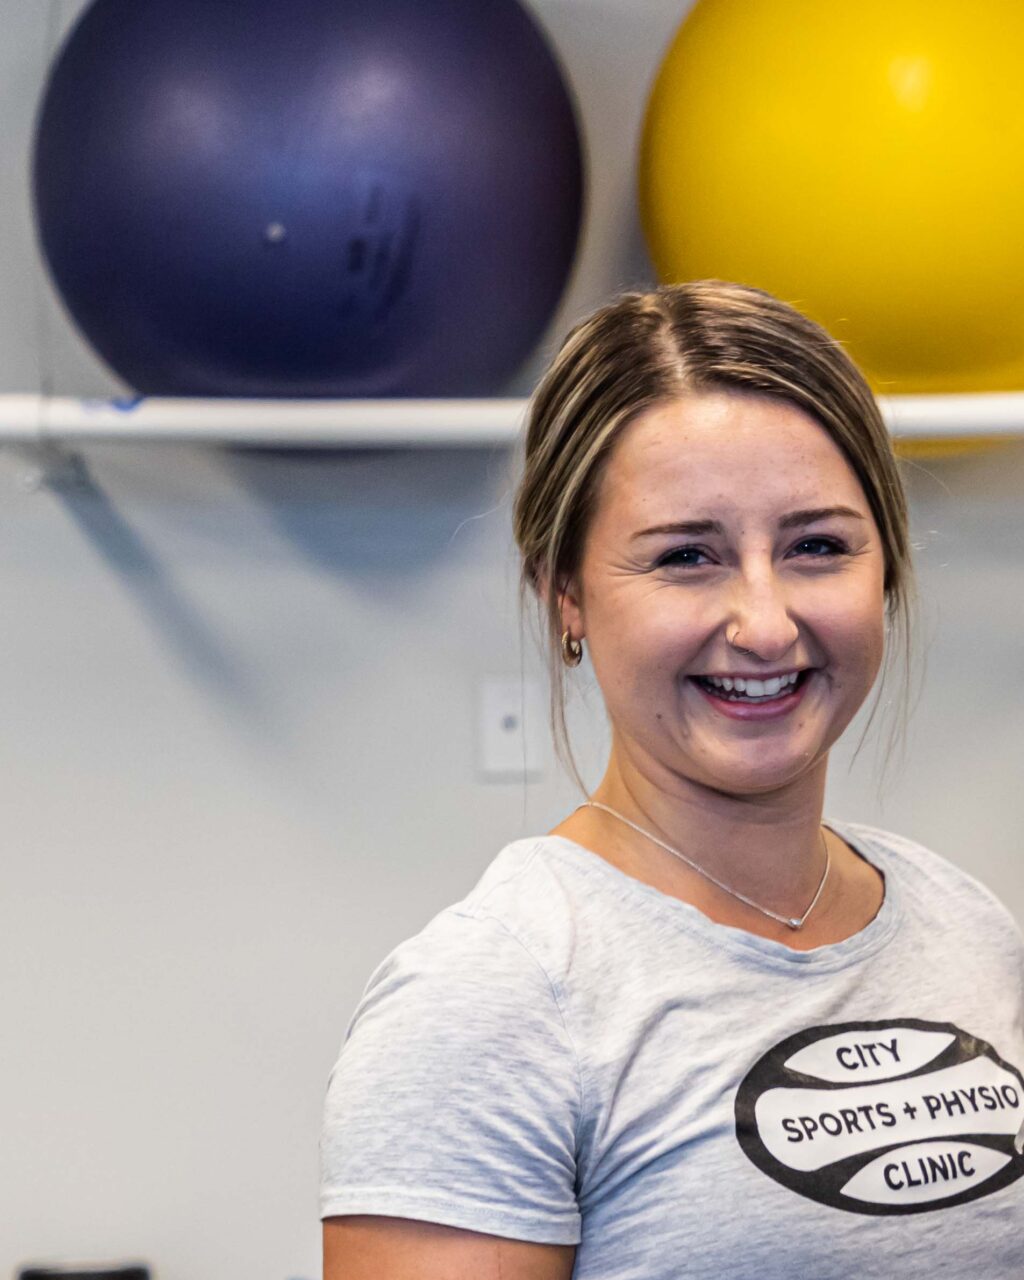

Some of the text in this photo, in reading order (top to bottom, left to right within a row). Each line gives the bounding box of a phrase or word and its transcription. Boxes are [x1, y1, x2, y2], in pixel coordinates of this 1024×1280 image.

[836, 1039, 901, 1070] CITY
[781, 1103, 897, 1143] SPORTS
[922, 1084, 1020, 1120] PHYSIO
[883, 1151, 976, 1191] CLINIC
